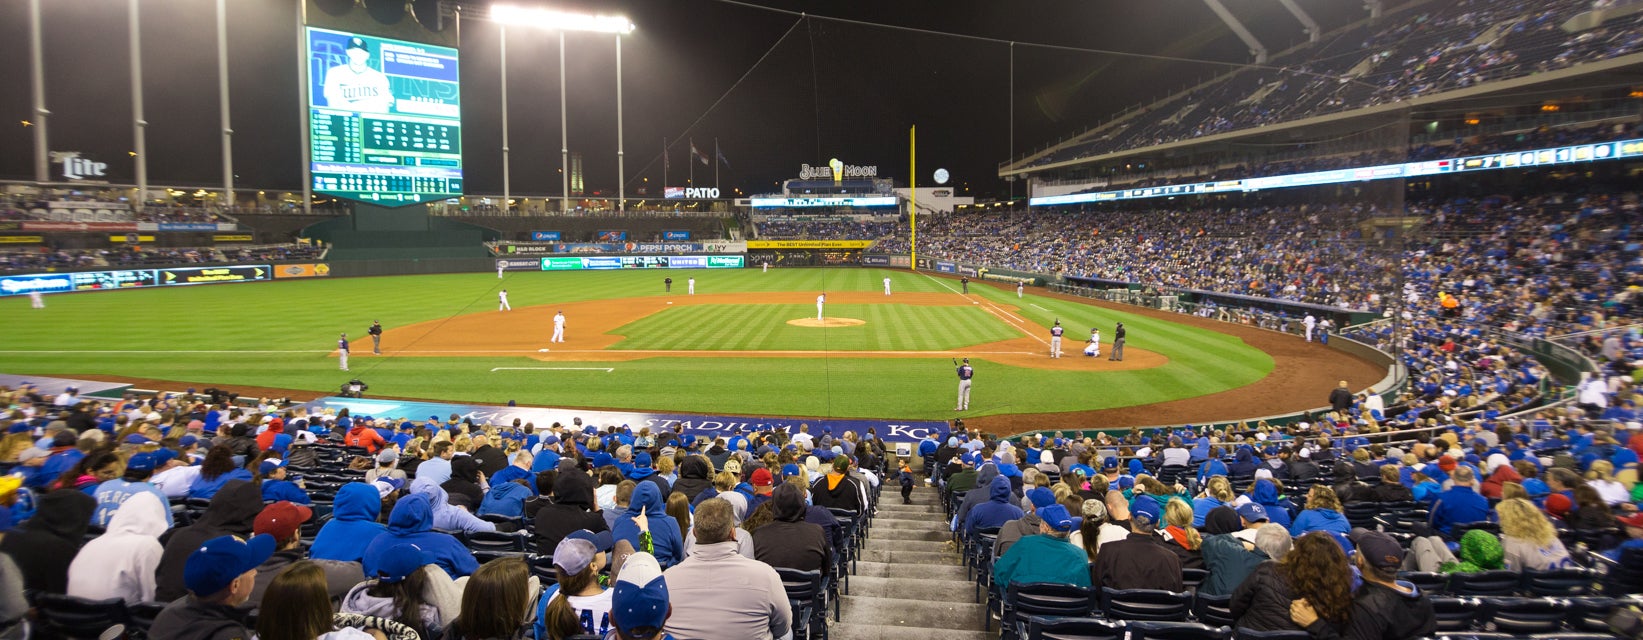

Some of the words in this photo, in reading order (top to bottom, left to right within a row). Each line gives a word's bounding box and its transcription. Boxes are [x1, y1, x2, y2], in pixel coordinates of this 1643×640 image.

[62, 157, 107, 180] Lite
[800, 164, 831, 180] BLUE
[845, 165, 877, 177] MOON
[685, 187, 720, 199] PATIO
[640, 244, 662, 252] PEPSI
[750, 254, 774, 263] Sprint
[887, 424, 929, 440] KC
[98, 490, 132, 505] PERE
